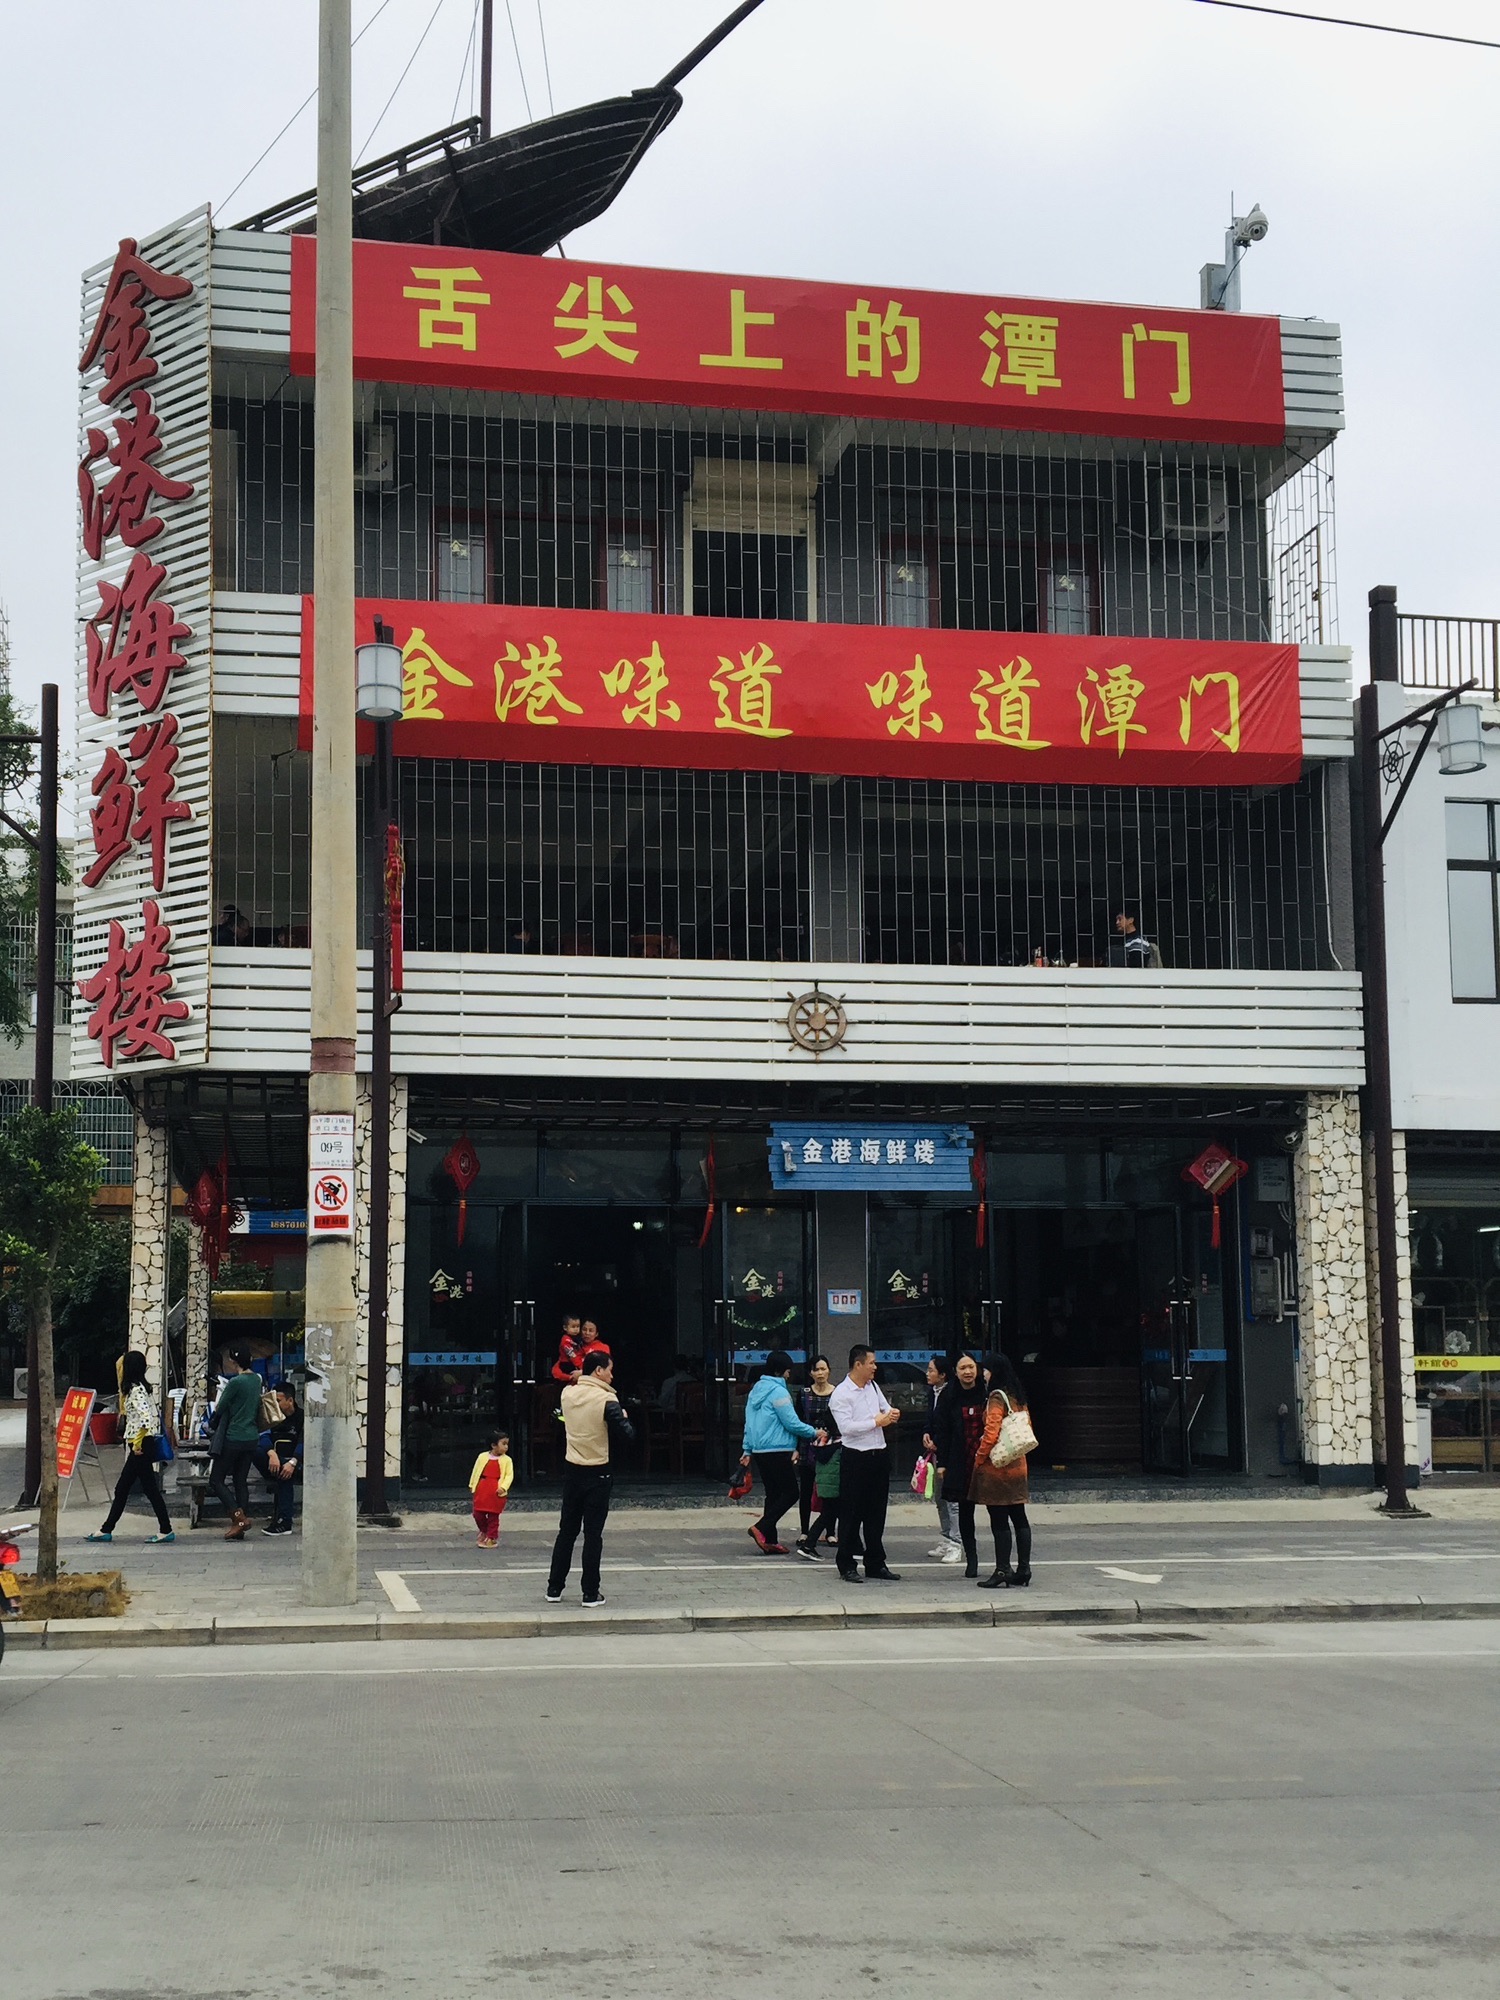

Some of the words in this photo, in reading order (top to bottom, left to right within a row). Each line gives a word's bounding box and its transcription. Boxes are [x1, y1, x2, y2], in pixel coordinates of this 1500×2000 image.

[404, 267, 1190, 404] 舌尖上的潭门
[77, 240, 193, 1067] 金港海鲜楼
[402, 628, 791, 738] 金港味道
[868, 656, 1239, 754] 味道潭门
[320, 1141, 343, 1154] 09号
[802, 1137, 935, 1165] 金港海鲜楼
